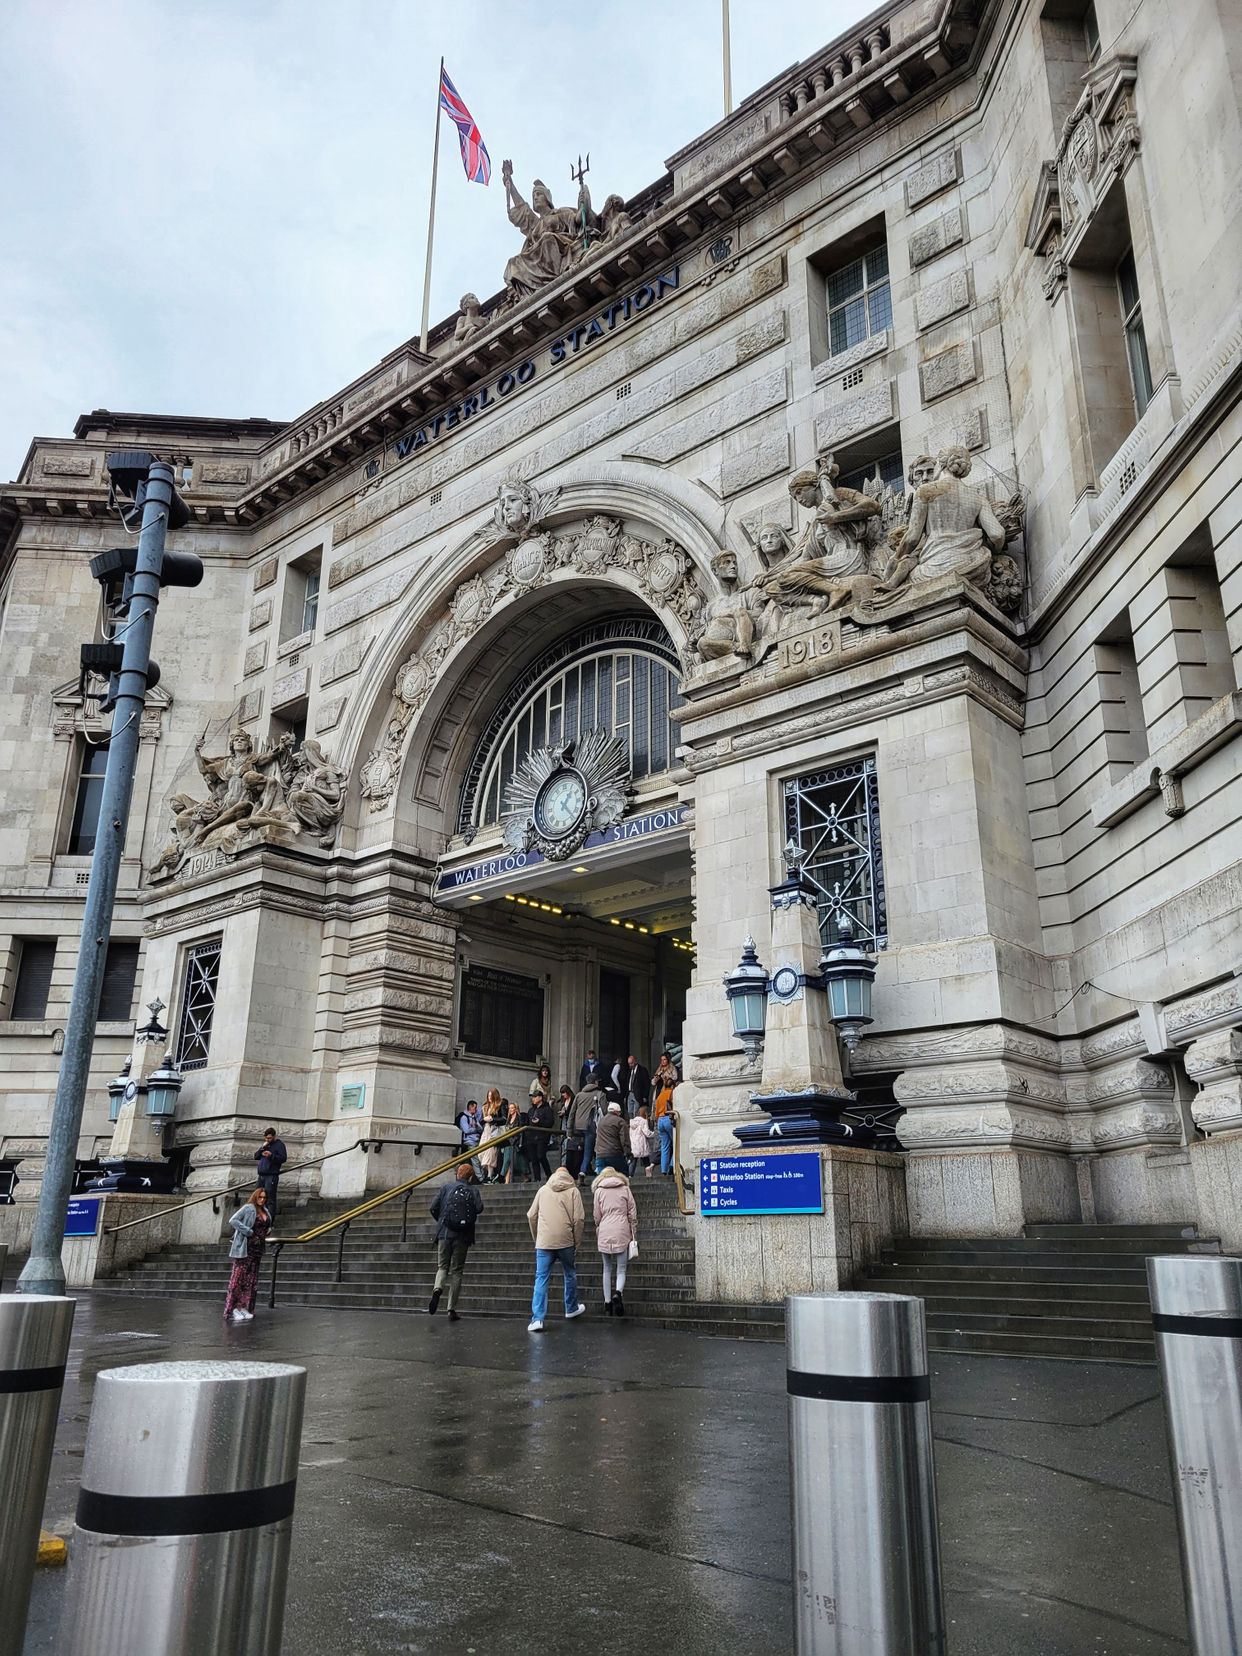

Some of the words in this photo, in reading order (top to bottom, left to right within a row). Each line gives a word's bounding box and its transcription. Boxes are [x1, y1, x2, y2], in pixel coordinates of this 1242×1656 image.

[393, 359, 536, 459] WATERLOO
[550, 265, 682, 365] STATION
[602, 619, 656, 639] COMPANY
[781, 630, 834, 669] 1918
[613, 810, 679, 841] STATION
[454, 853, 527, 885] WATERLOO
[719, 1161, 739, 1169] Station
[739, 1160, 766, 1169] reception
[719, 1173, 744, 1181] Waterloo
[744, 1172, 765, 1180] Station
[719, 1198, 738, 1207] Cycles
